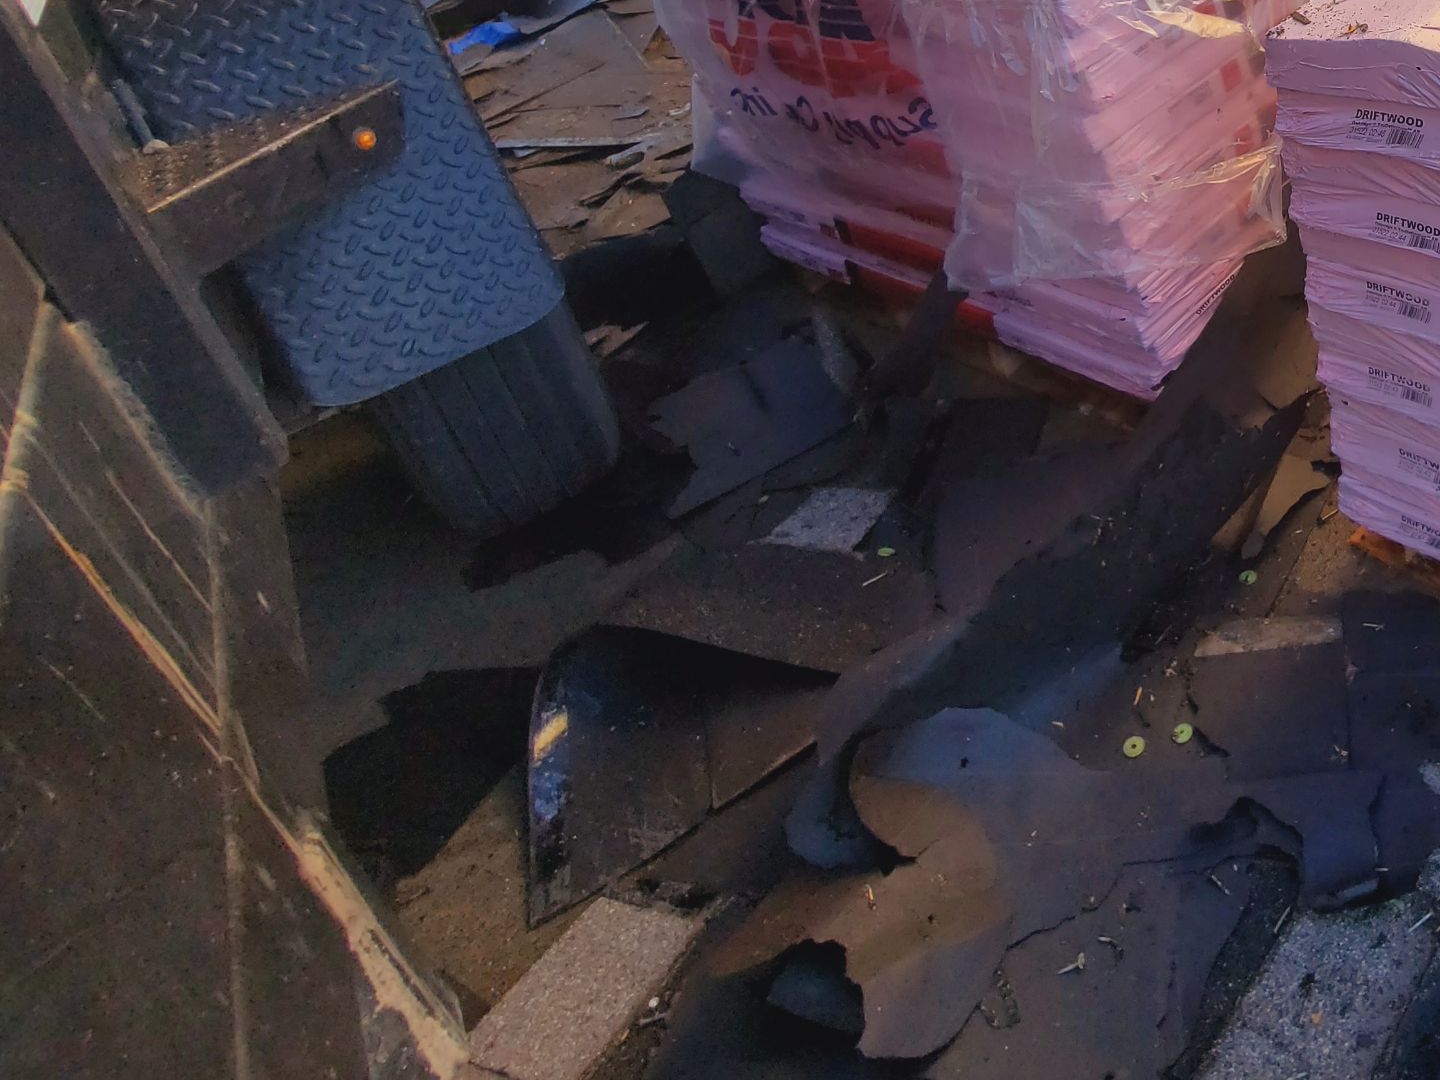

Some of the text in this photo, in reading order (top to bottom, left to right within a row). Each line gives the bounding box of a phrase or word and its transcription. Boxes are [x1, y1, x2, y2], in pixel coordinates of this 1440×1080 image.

[1355, 109, 1424, 128] DRIFTWOOD
[1376, 212, 1440, 237] DRIFTWOOD
[1366, 281, 1430, 307] DRIFTWOOD
[1368, 366, 1431, 392] DRIFTWOOD
